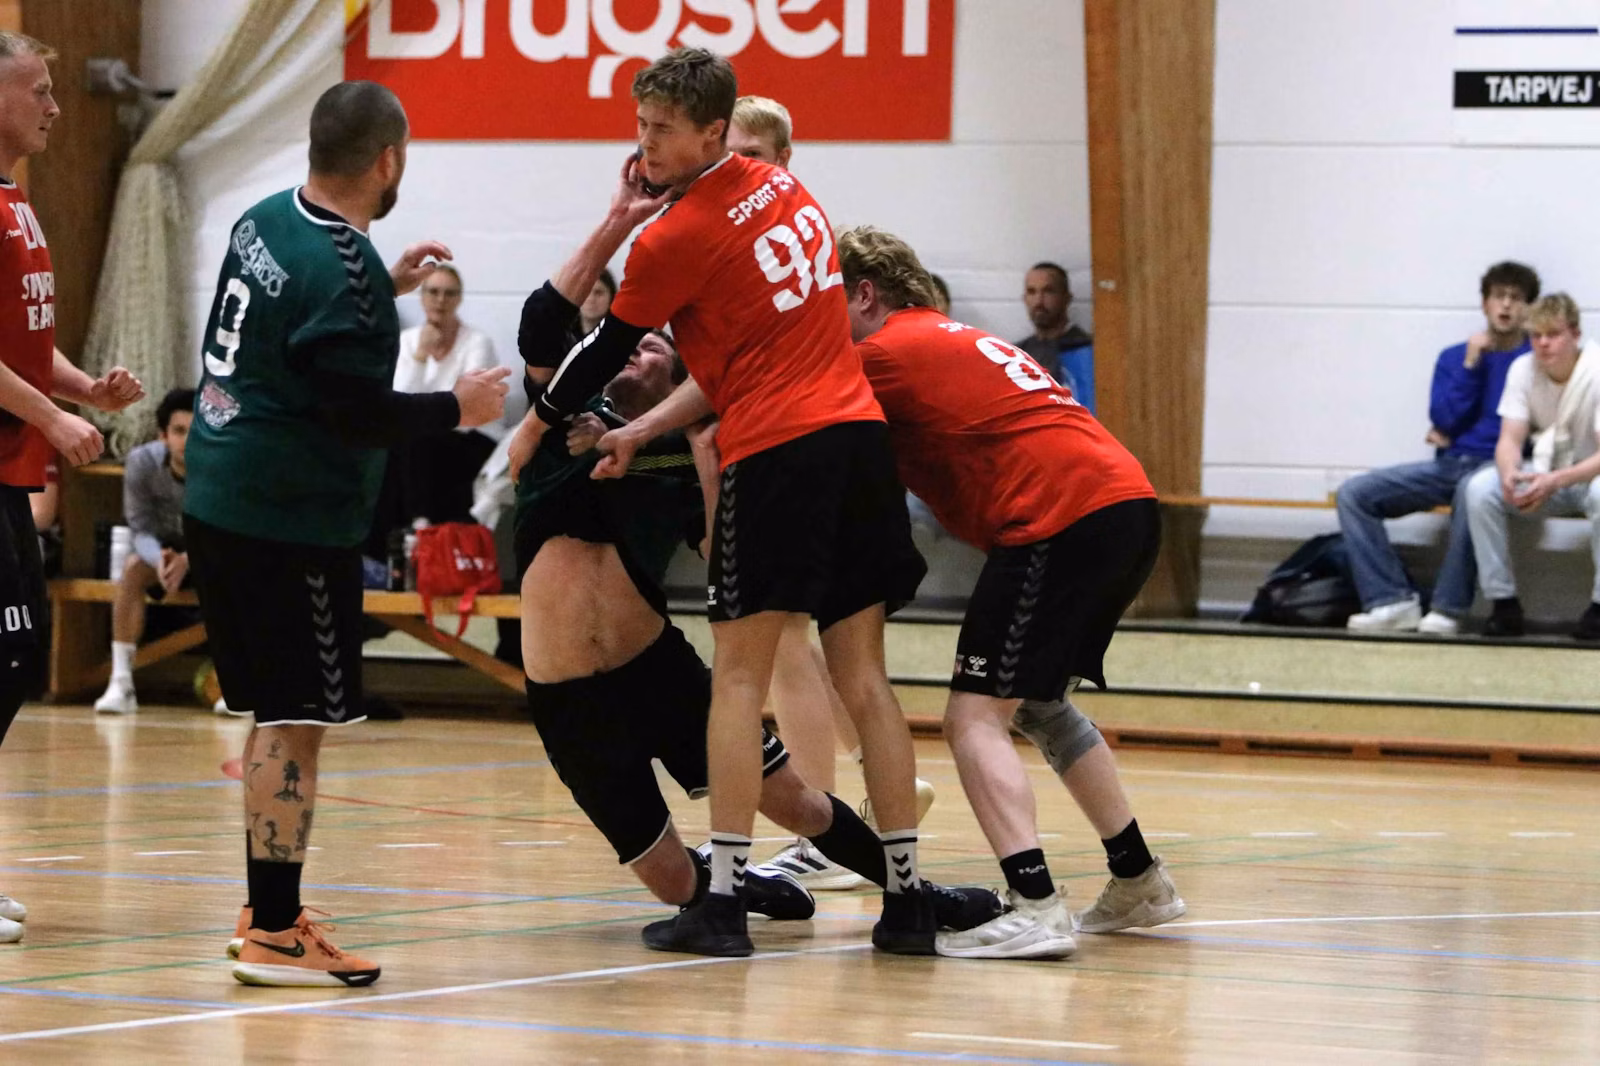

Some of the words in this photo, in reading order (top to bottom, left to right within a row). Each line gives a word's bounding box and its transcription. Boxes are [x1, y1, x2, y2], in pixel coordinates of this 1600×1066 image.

[1484, 75, 1593, 104] TARPVEJ
[727, 183, 777, 226] SPORT
[753, 205, 844, 313] 92
[204, 277, 250, 377] 9
[976, 336, 1062, 391] 8
[0, 604, 32, 633] 00
